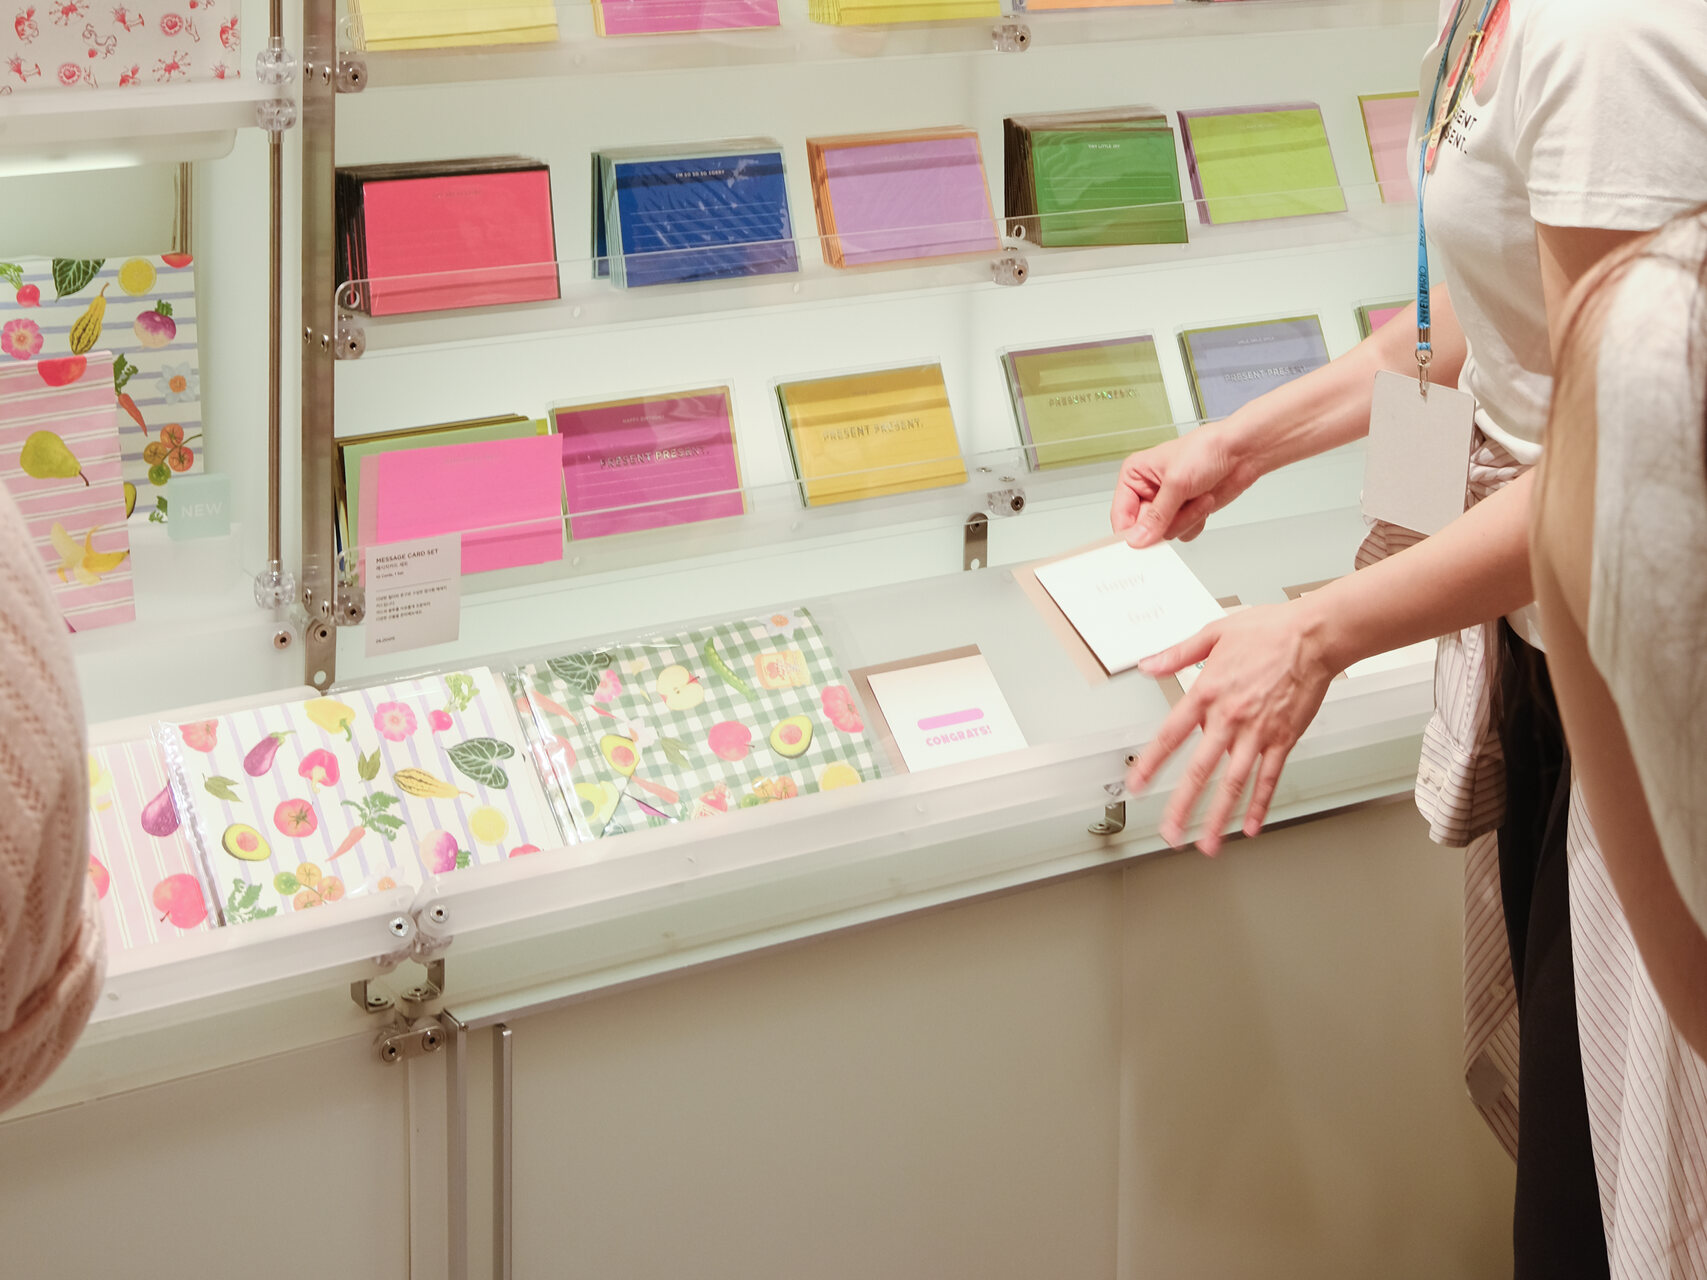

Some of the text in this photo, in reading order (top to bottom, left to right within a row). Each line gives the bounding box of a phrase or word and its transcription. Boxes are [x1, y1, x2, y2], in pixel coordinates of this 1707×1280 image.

[1224, 368, 1264, 384] PRESENT
[823, 417, 924, 441] PRESENT PRESENT.
[600, 446, 710, 469] PRESENT PRESENT.
[181, 501, 223, 518] NEW
[376, 548, 438, 564] MESSAGE CARD SET
[925, 724, 991, 746] CONGRATS!
